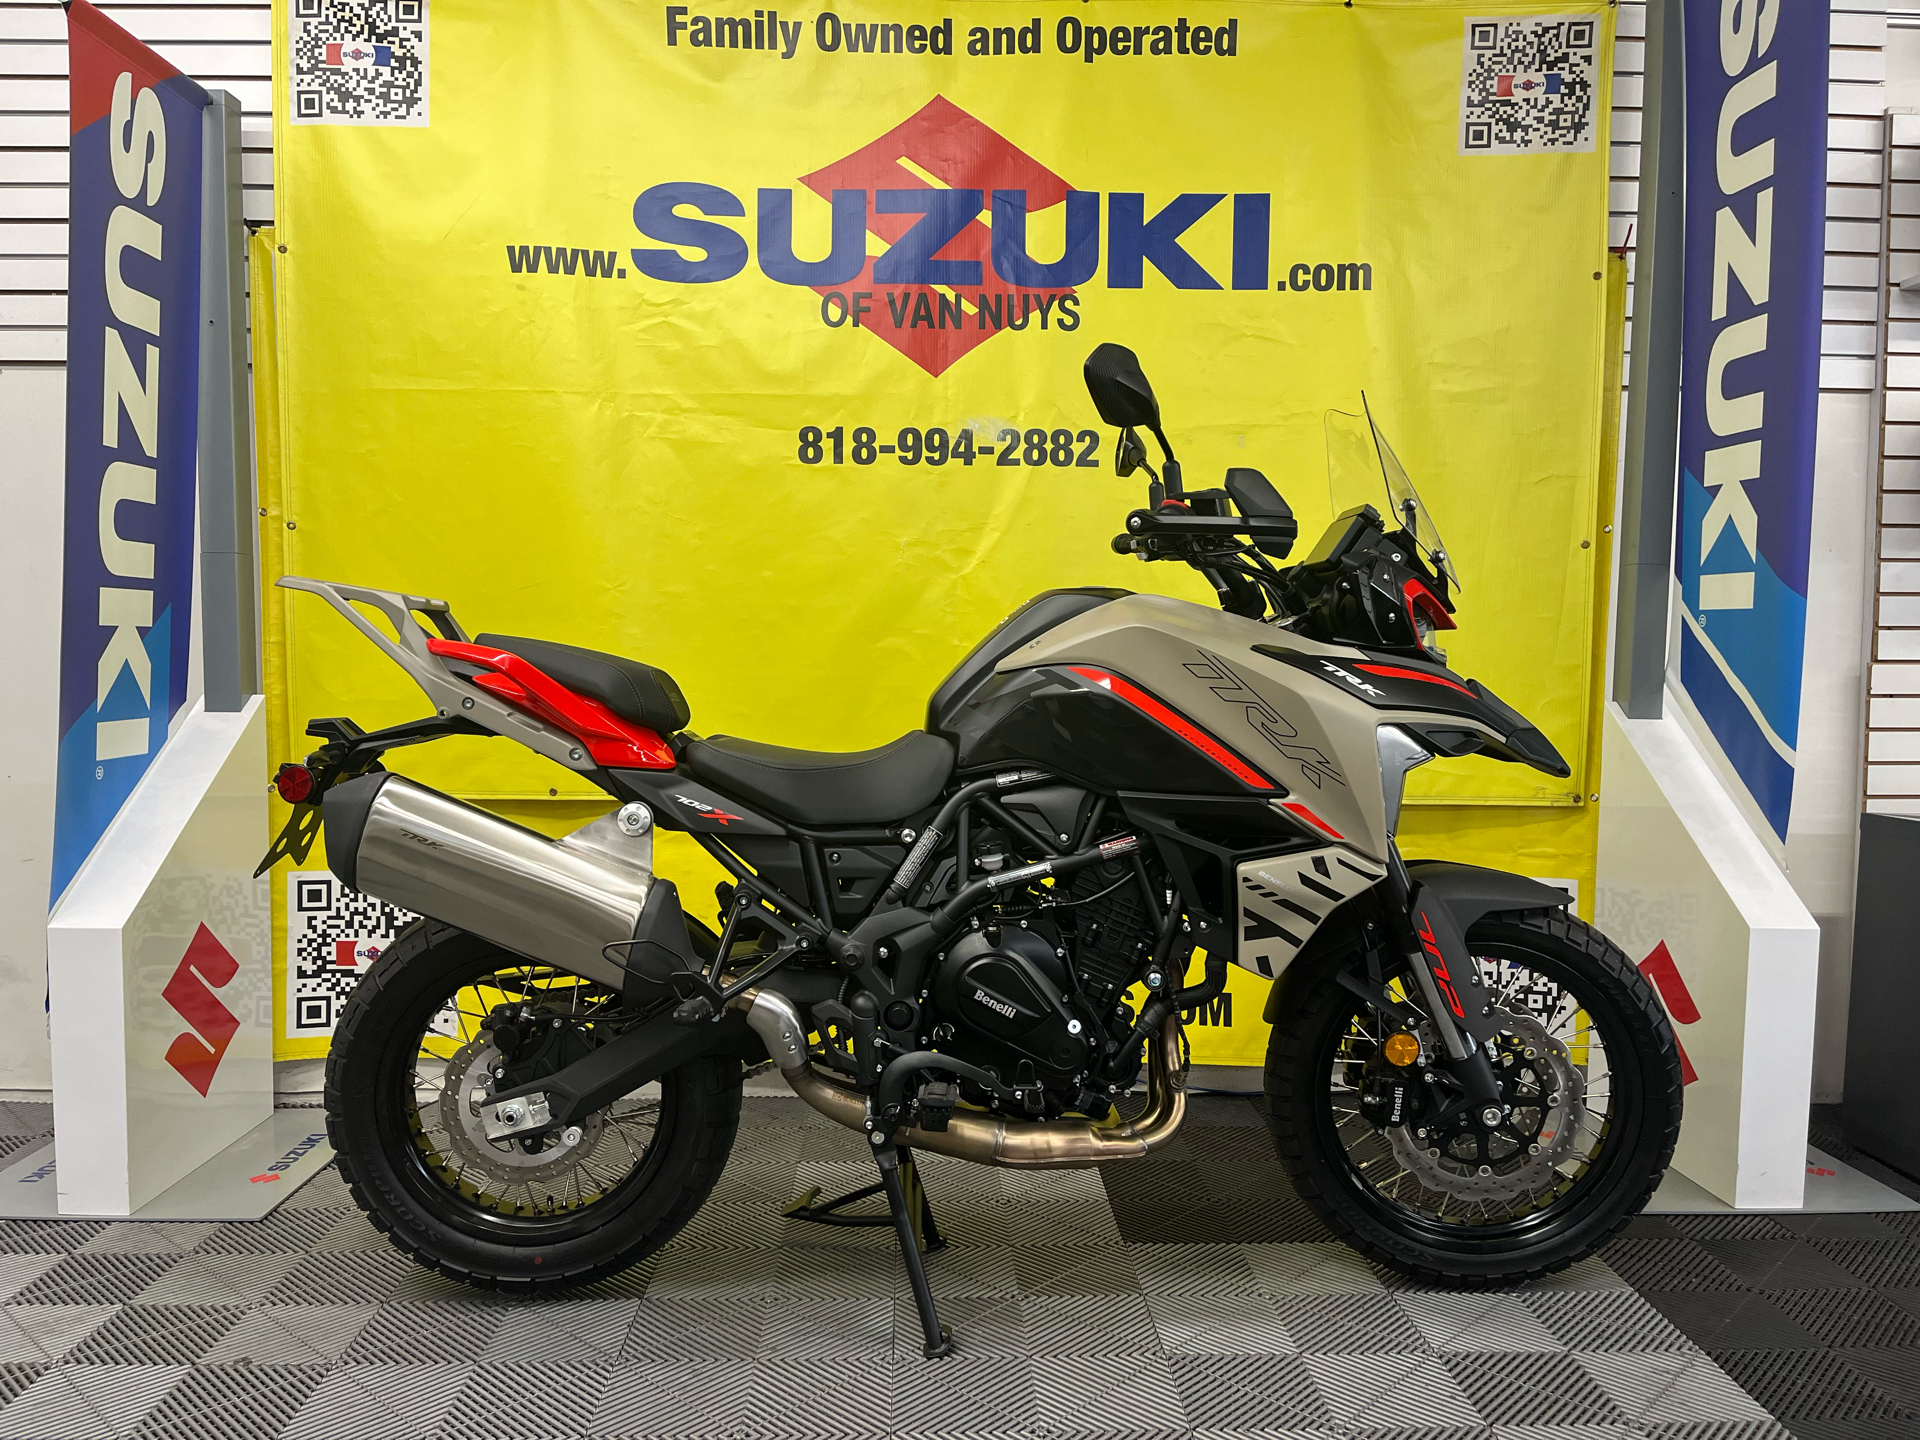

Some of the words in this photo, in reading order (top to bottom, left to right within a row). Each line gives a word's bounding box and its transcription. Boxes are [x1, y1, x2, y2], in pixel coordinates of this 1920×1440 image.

[666, 6, 802, 59] Family
[815, 12, 953, 55] Owned
[967, 17, 1041, 56] and
[1056, 16, 1238, 63] Operated
[342, 50, 374, 60] SUZUKI
[1513, 81, 1545, 90] SUZUKI
[821, 291, 872, 328] OF
[886, 292, 962, 330] VAN
[978, 293, 1081, 332] NUYS
[1698, 0, 1780, 611] SUZUKI
[95, 71, 167, 762] SUZUKI
[797, 425, 1100, 468] 818-994-2882
[1319, 659, 1387, 698] TRK
[400, 828, 446, 850] TRK
[973, 988, 1018, 1019] Benelli
[1390, 1086, 1404, 1122] Benelli
[267, 1133, 329, 1172] SUZUKI
